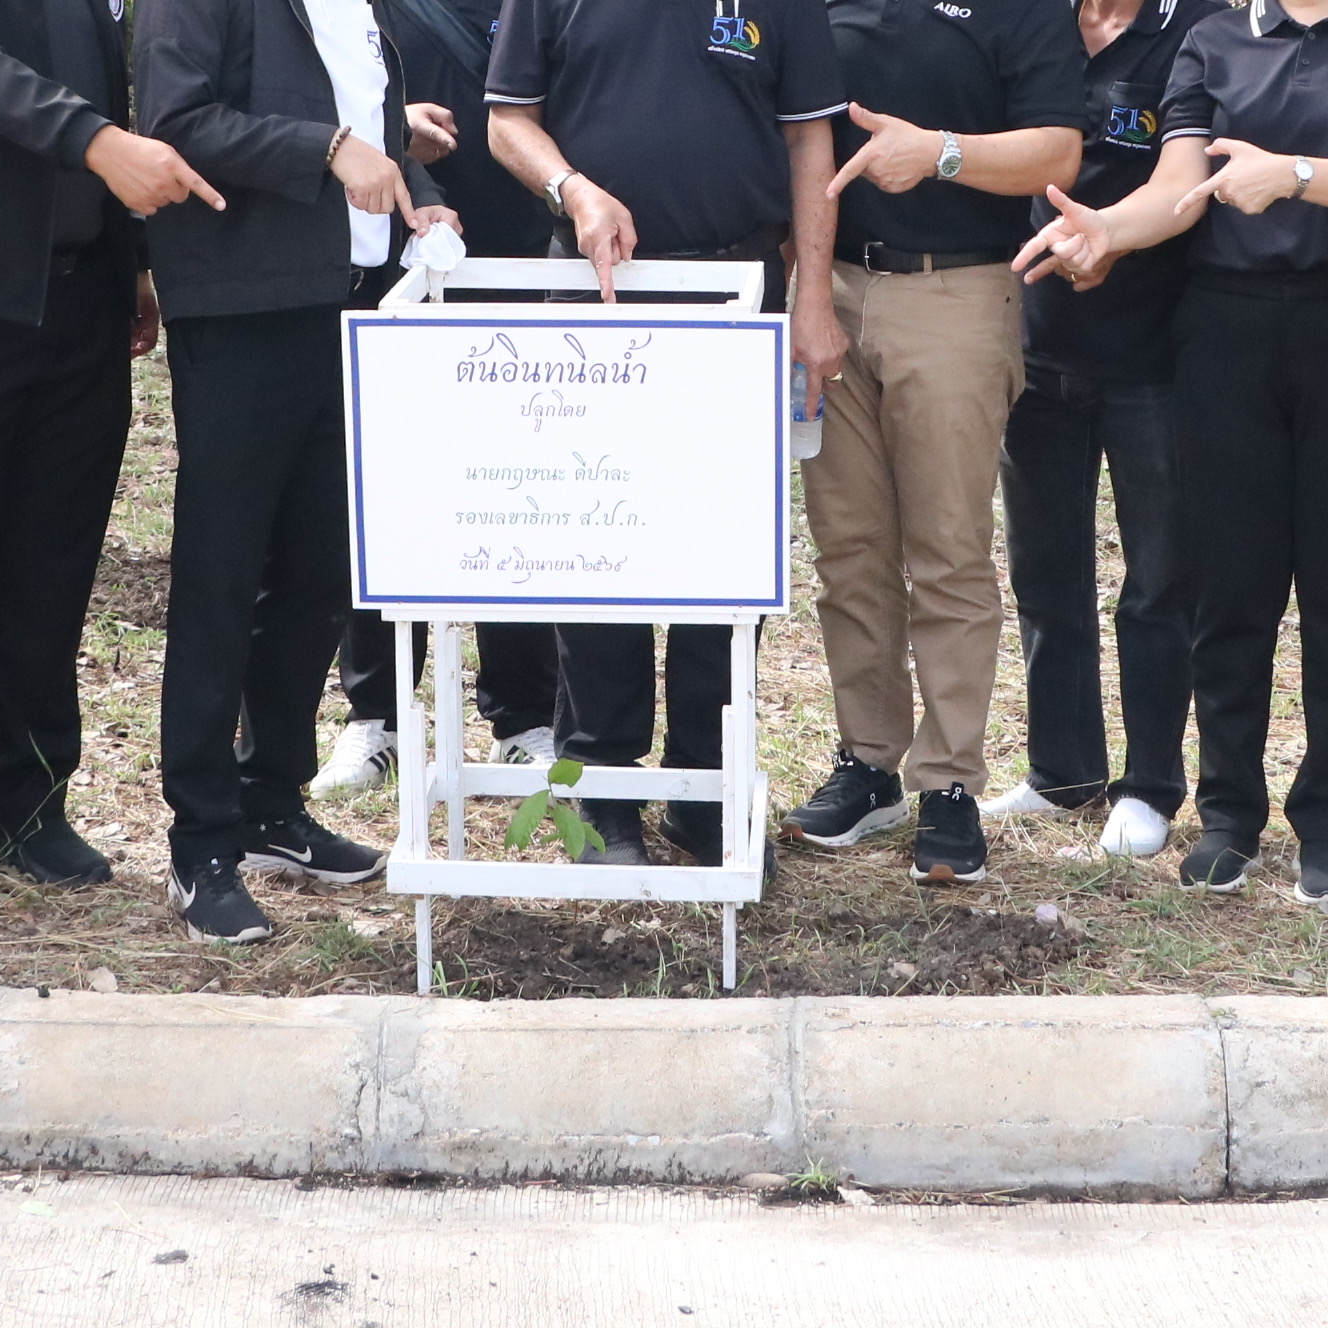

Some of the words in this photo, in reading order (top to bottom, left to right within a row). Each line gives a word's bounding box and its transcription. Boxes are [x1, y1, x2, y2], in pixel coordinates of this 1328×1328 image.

[1107, 104, 1140, 136] 51
[456, 330, 653, 385] ต้นอินทนิลน้ำ
[520, 388, 587, 433] ปลูกโดย
[455, 495, 571, 526] รองเลขาธิการ
[459, 545, 491, 571] วันที่
[510, 545, 575, 584] มิถุนายน
